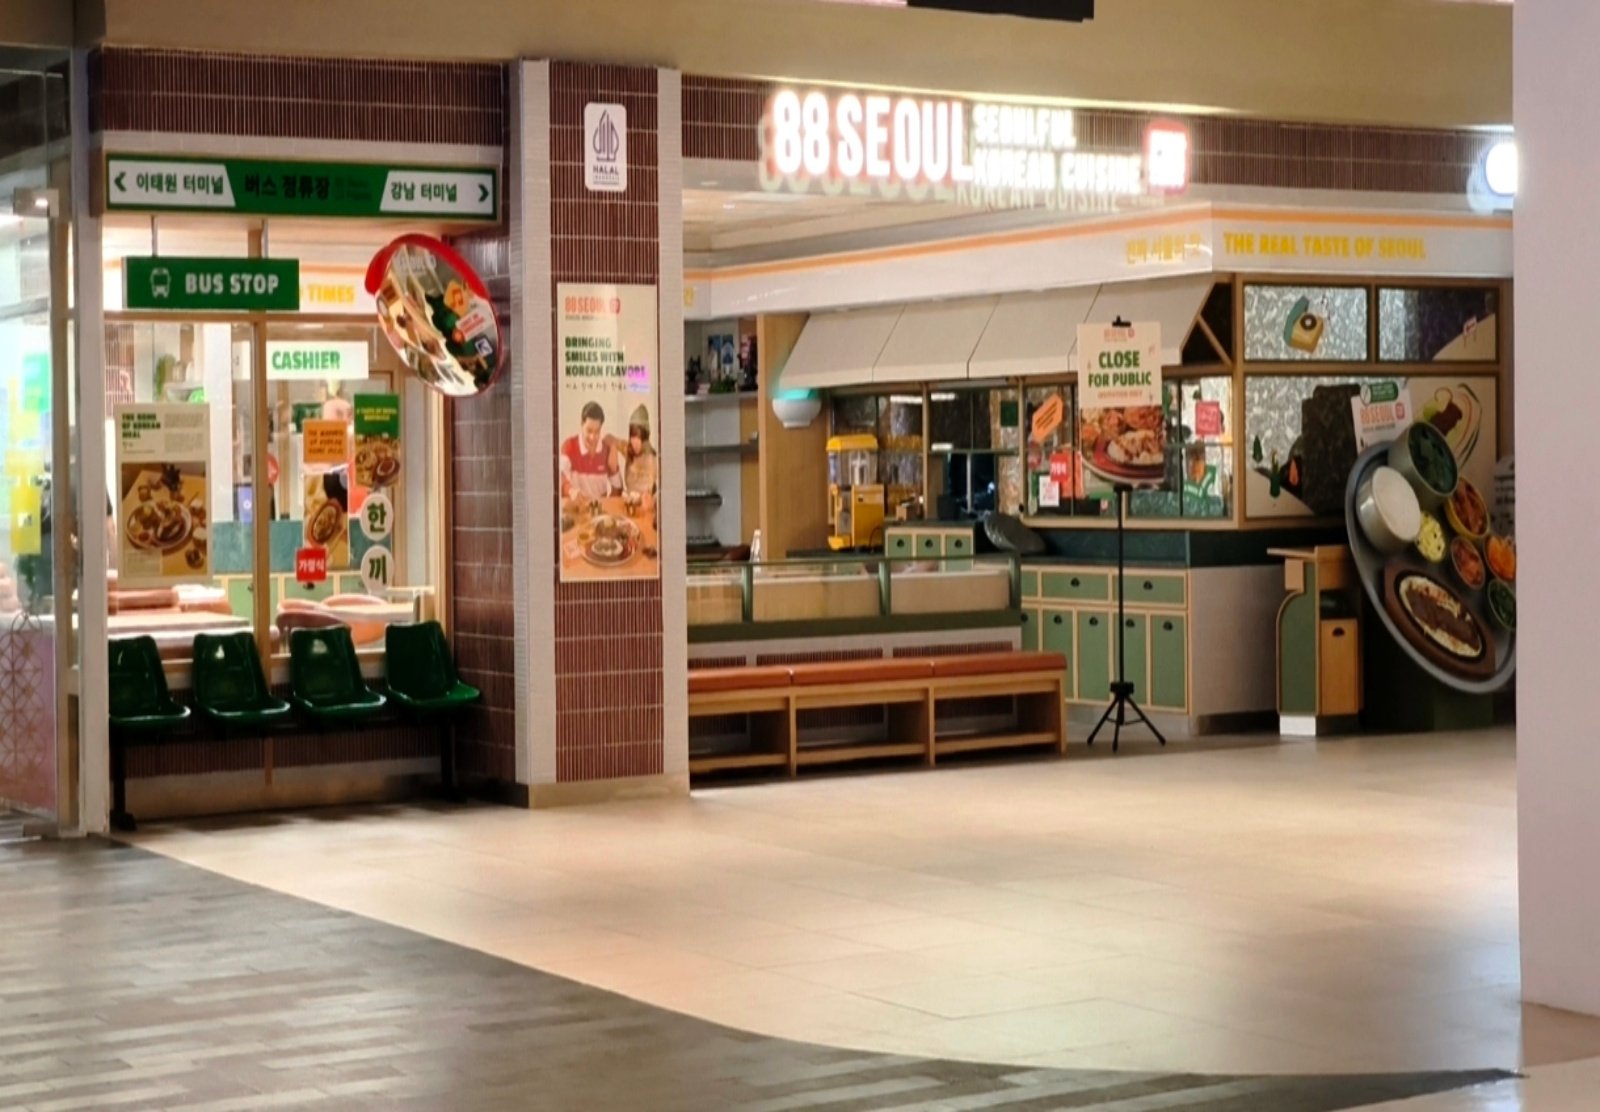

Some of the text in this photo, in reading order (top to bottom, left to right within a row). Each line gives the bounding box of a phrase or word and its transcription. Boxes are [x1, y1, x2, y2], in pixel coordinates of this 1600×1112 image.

[593, 165, 619, 176] HALAL
[972, 147, 1055, 189] KOREAN
[1060, 151, 1141, 194] CUISINE
[136, 172, 224, 195] 이태원 터미널
[244, 173, 278, 197] 버스
[282, 175, 330, 199] 정류장
[391, 182, 415, 201] 강남
[421, 182, 457, 202] 터미널
[1223, 232, 1426, 259] THE REAL TASTE OF SEOUL
[185, 273, 279, 294] BUS STOP
[307, 284, 355, 304] TIMES
[565, 297, 606, 314] 88SEOU
[565, 337, 611, 348] BRINGING
[272, 350, 341, 370] CASHIER
[565, 352, 624, 362] SMILES WITH
[1099, 350, 1140, 369] CLOSE
[565, 366, 603, 377] KOREAN
[1088, 371, 1152, 388] FOR PUBLIC
[367, 502, 387, 533] 한
[369, 554, 387, 585] 끼
